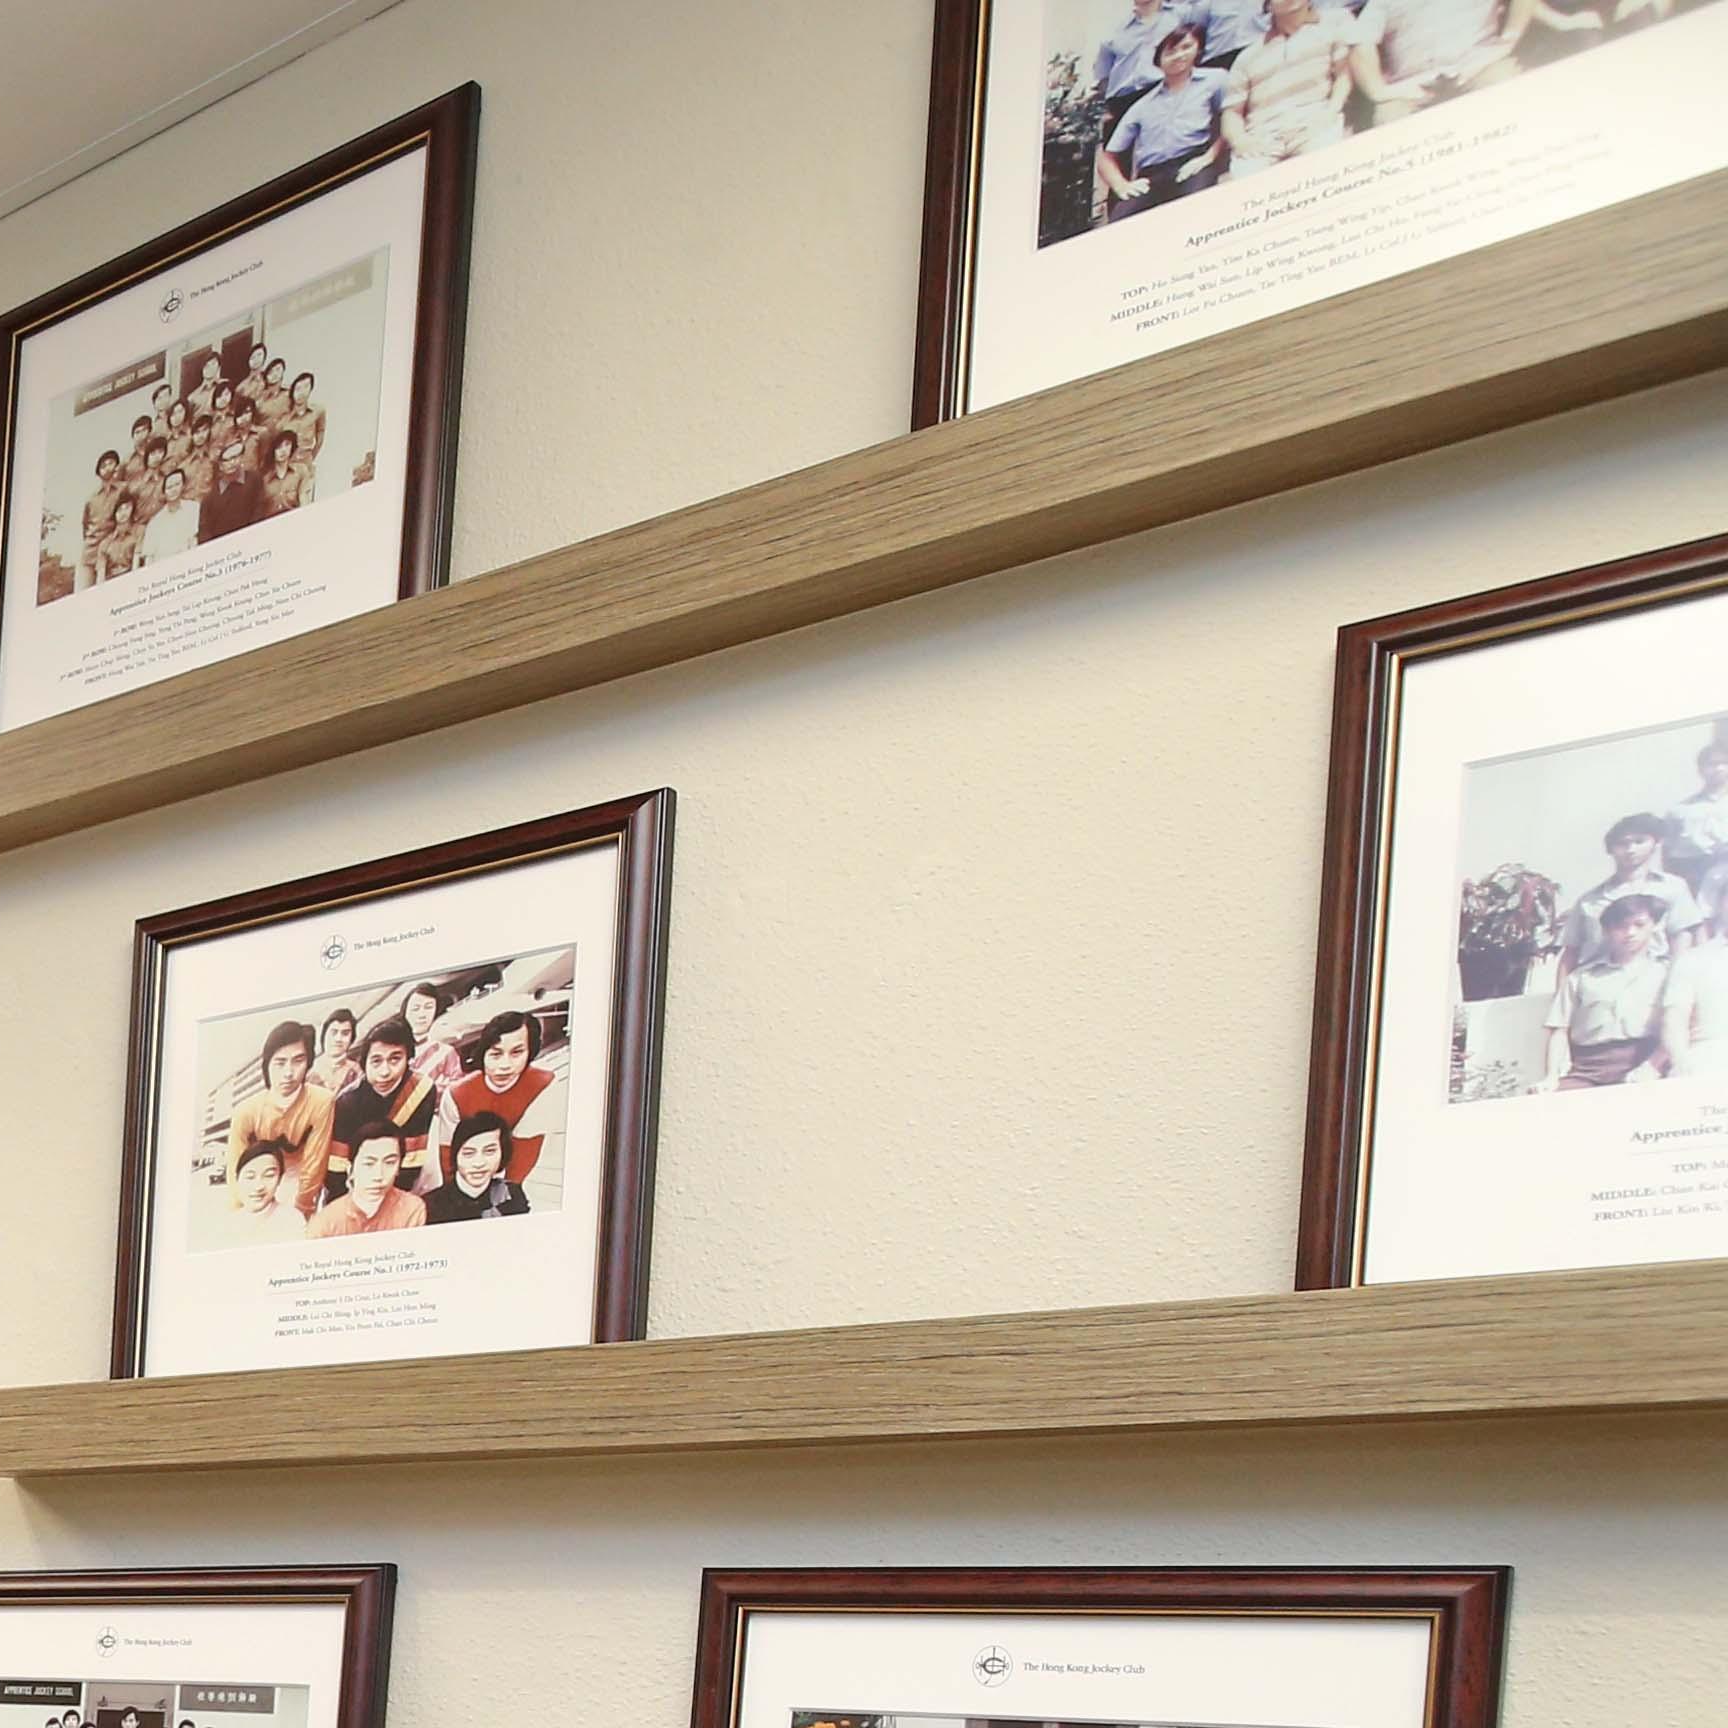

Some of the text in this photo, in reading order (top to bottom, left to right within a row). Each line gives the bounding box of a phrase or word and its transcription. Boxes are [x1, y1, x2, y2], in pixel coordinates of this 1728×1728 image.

[1630, 1125, 1722, 1143] Apprentice
[1591, 1187, 1656, 1201] MIDDLE:
[268, 1274, 309, 1287] Apprentice
[310, 1272, 340, 1283] Jockeys
[342, 1269, 370, 1277] Course
[1023, 1661, 1146, 1675] The Hong Kong Jockey Club
